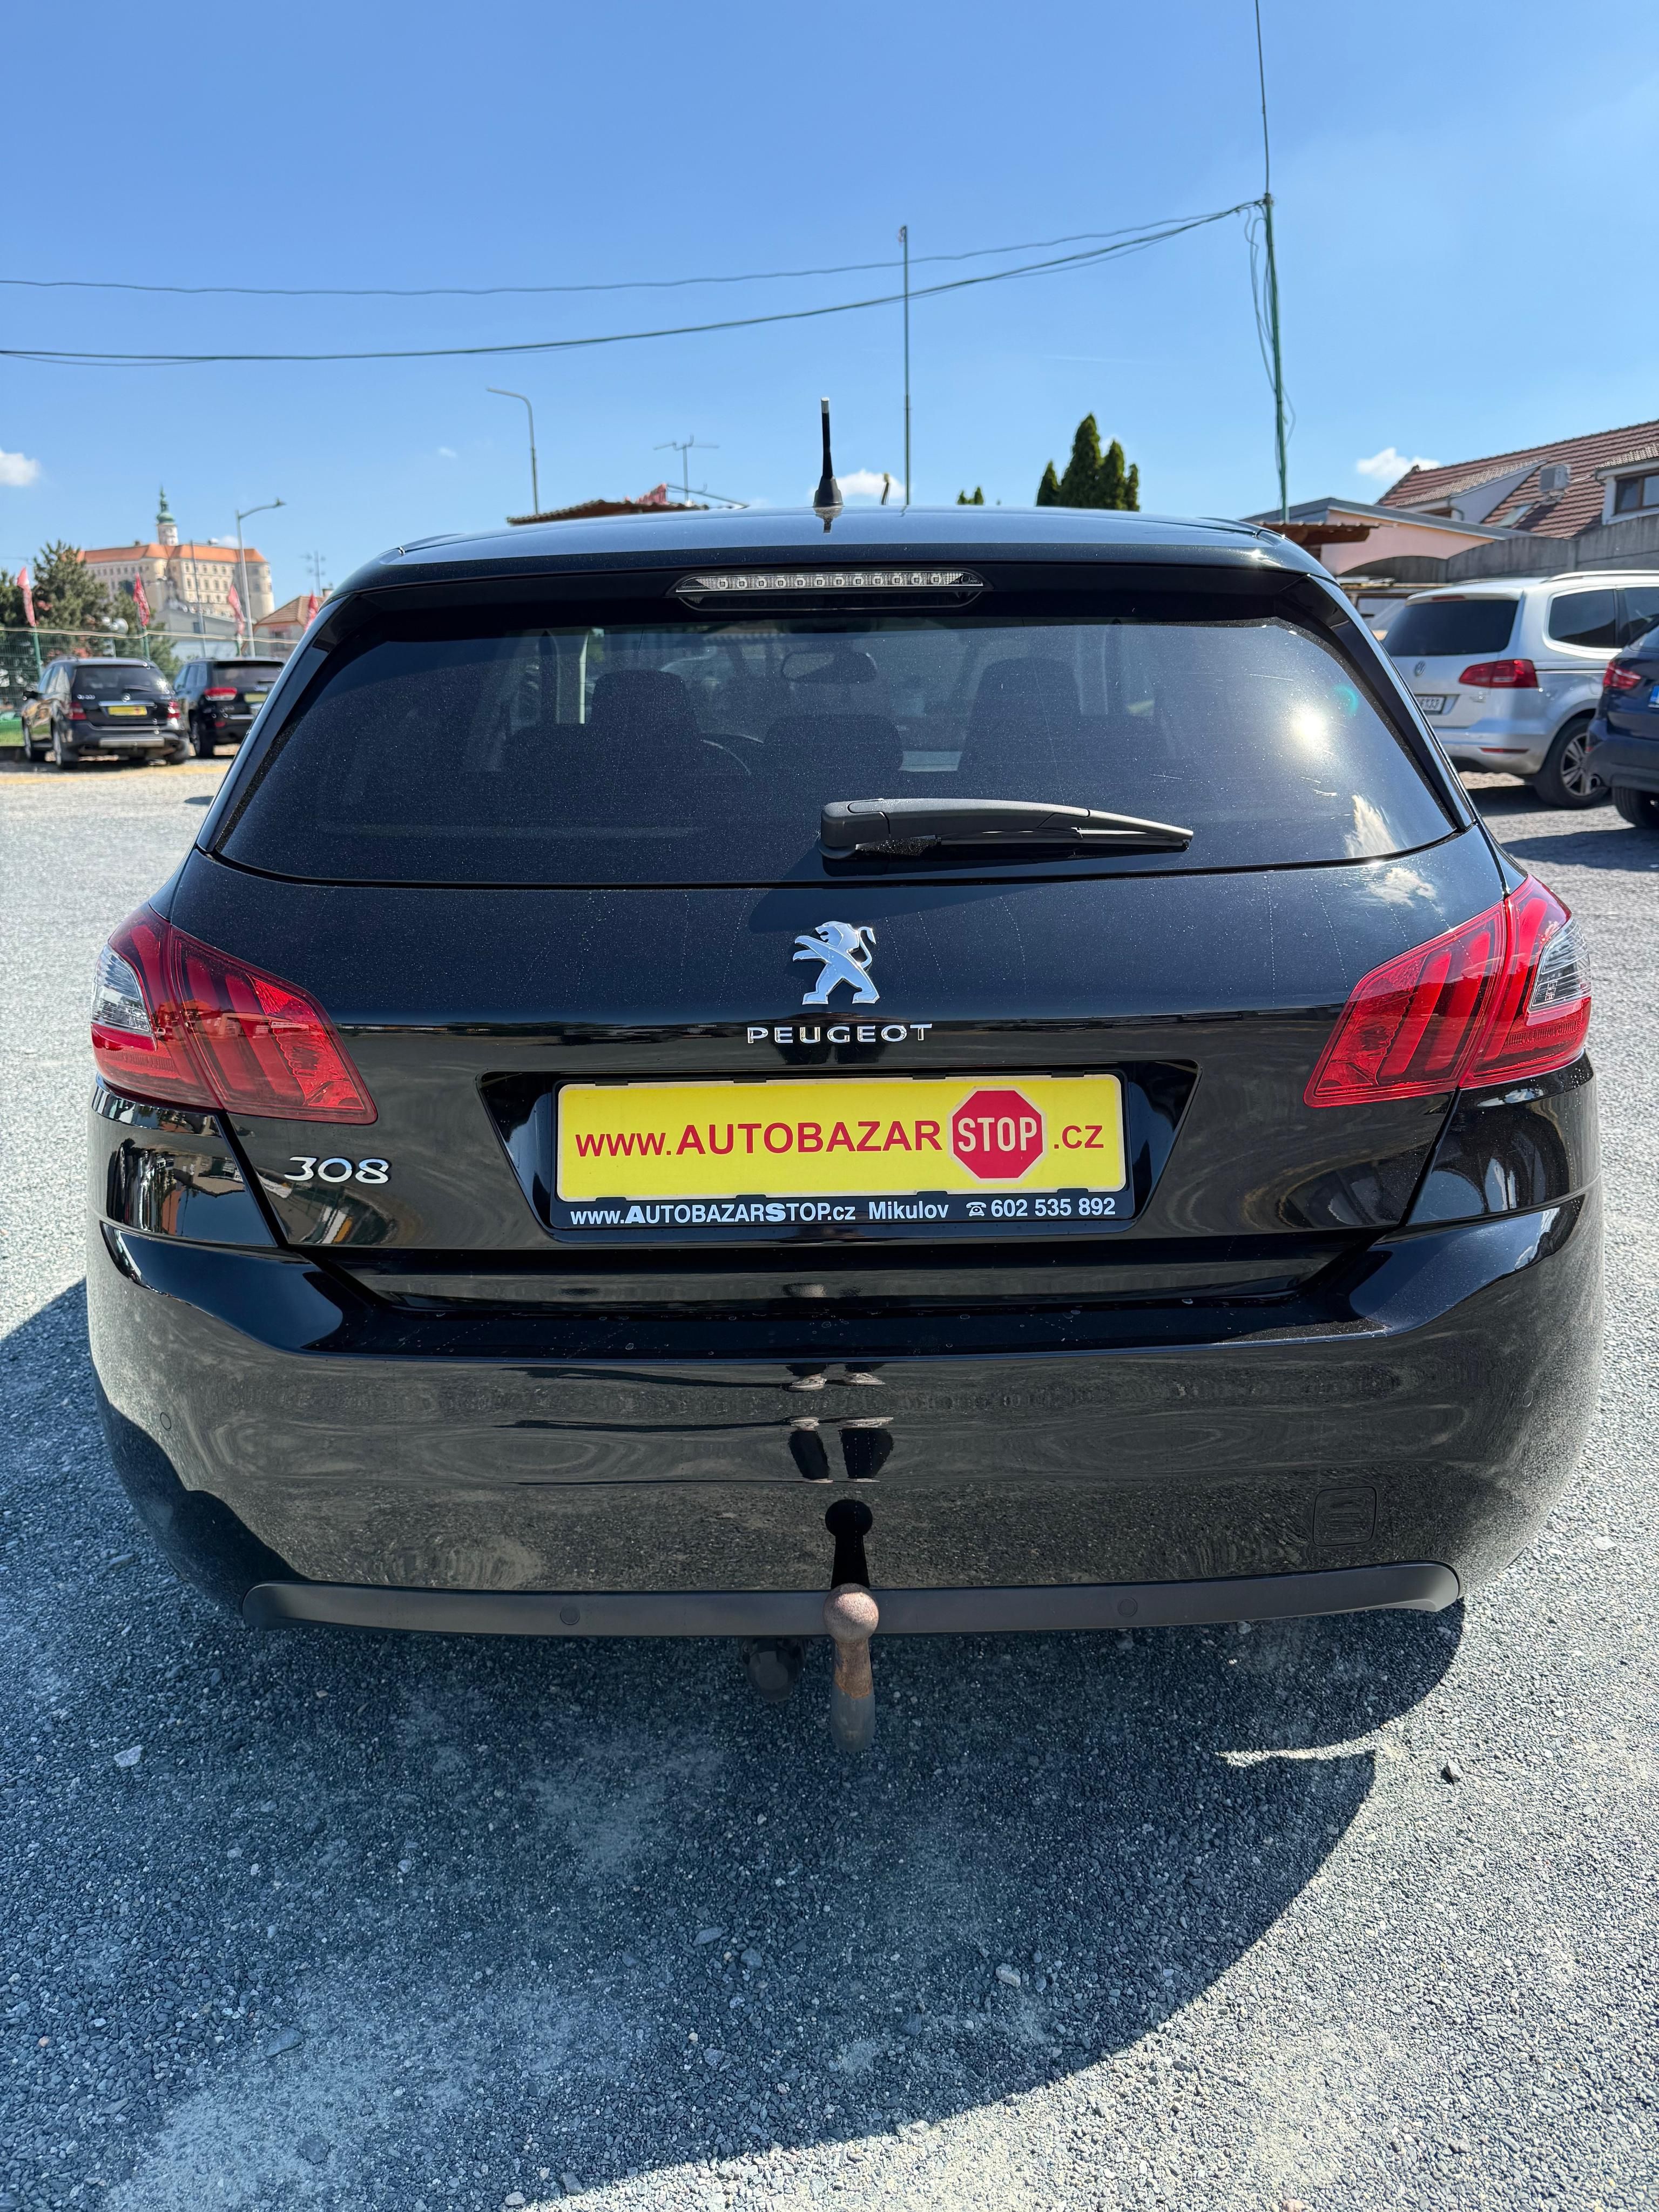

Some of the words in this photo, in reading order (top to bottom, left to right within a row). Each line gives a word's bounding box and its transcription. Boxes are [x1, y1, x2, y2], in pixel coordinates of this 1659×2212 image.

[747, 1023, 933, 1044] PEUGEOT
[957, 1117, 1037, 1152] STOP
[284, 1156, 389, 1184] 308
[570, 1203, 856, 1225] www.AUTOBAZARSTOP.cz
[868, 1201, 949, 1220] Mikulov
[991, 1199, 1028, 1217] 602
[1035, 1198, 1072, 1216] 535
[1078, 1197, 1116, 1215] 892
